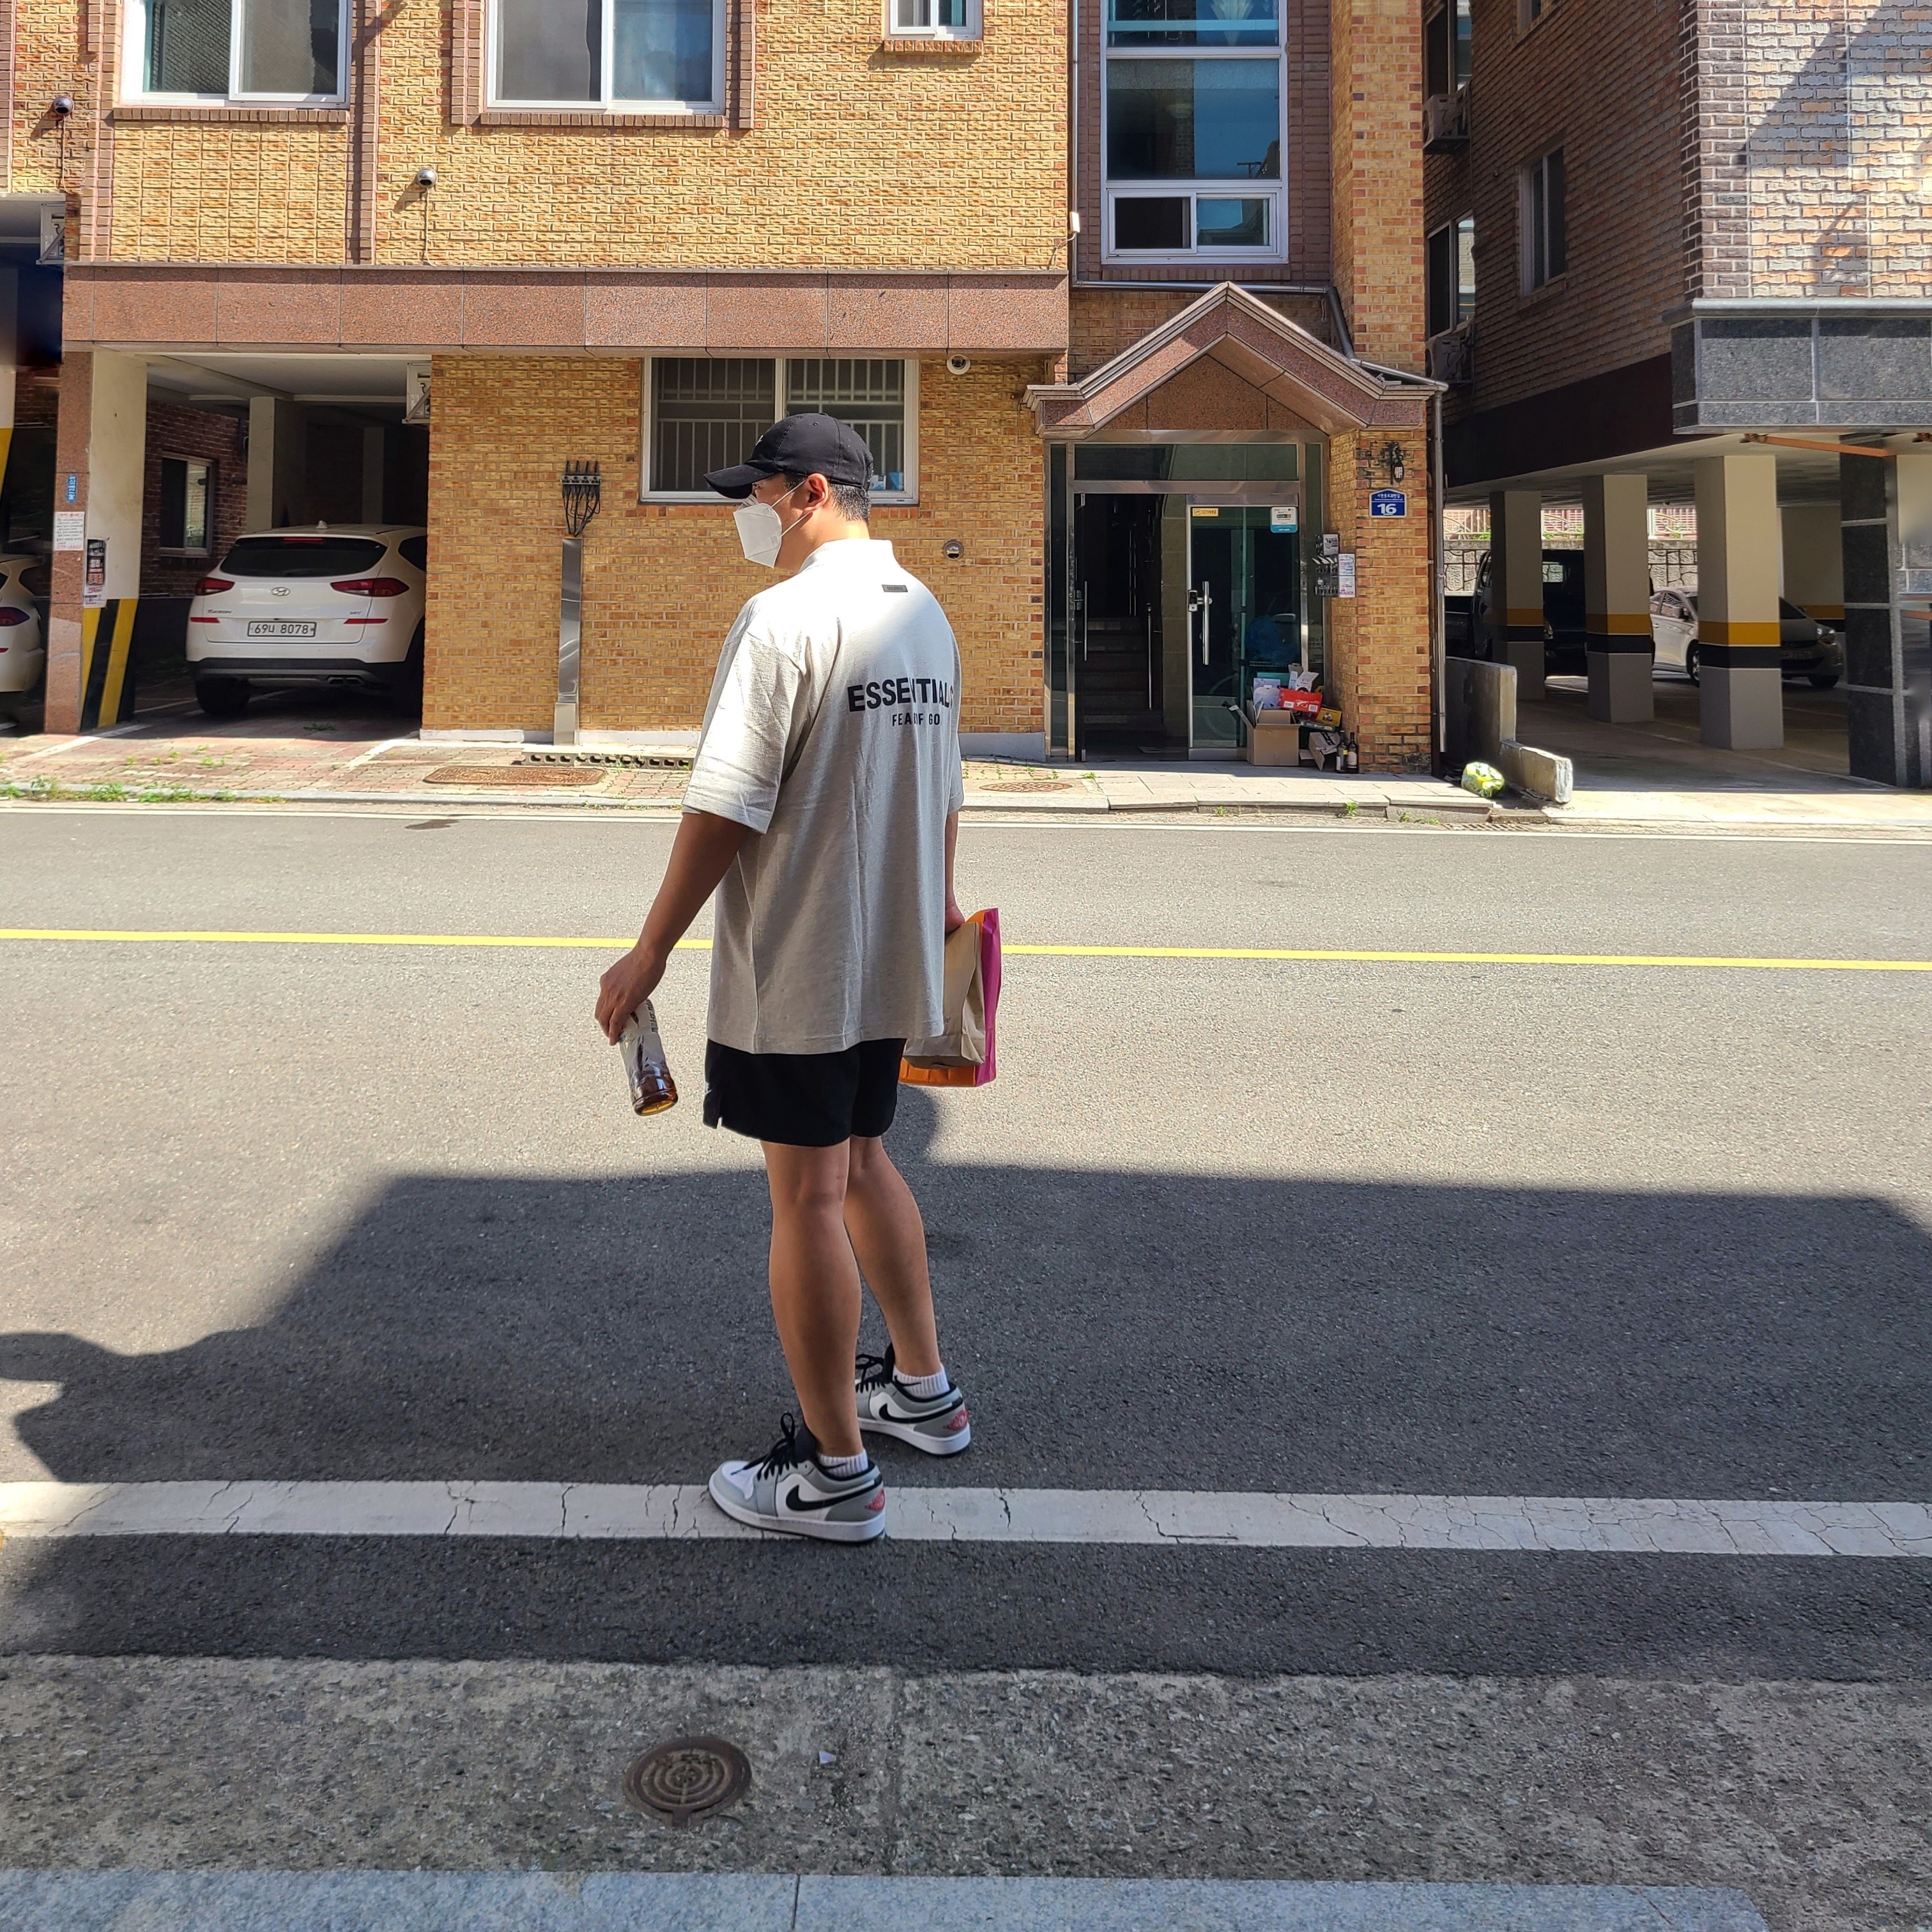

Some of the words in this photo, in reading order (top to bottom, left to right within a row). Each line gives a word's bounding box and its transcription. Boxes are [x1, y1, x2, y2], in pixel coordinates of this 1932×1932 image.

[1377, 503, 1397, 514] 16
[280, 624, 309, 634] 8078
[928, 713, 941, 725] GO
